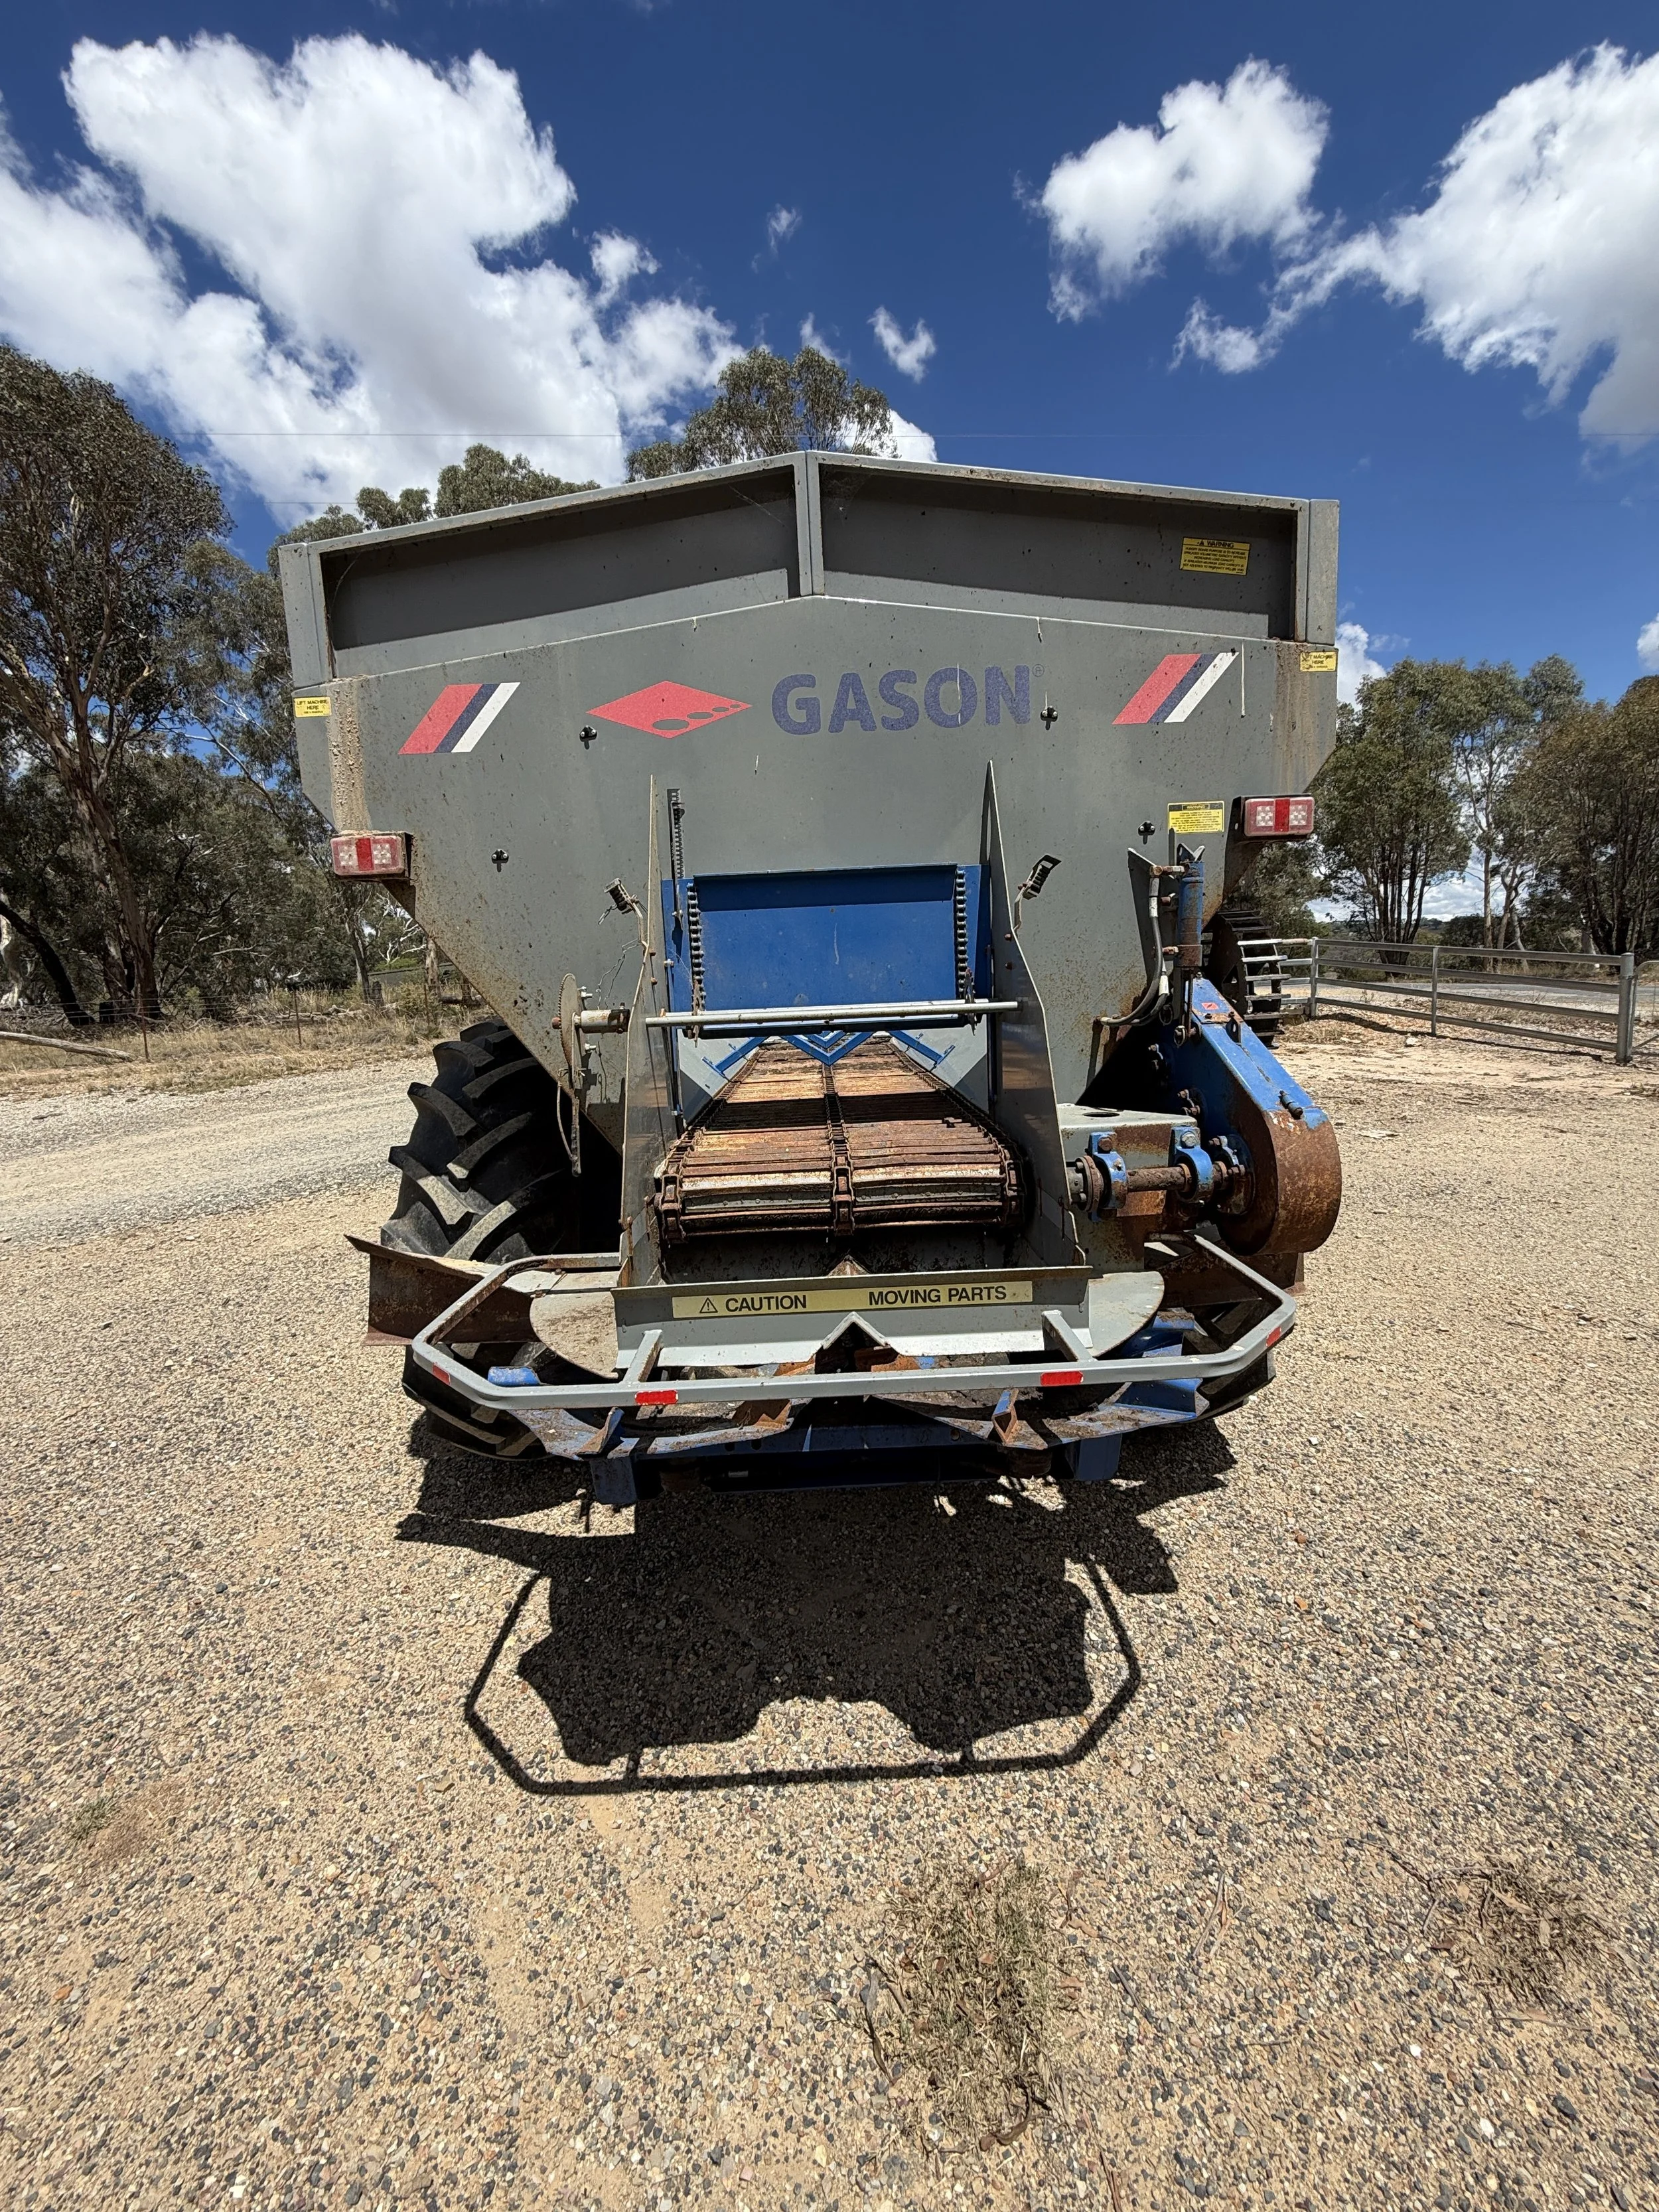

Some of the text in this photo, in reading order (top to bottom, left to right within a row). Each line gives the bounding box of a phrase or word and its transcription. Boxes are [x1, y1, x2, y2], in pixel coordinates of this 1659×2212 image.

[1207, 540, 1234, 549] WARNING
[771, 665, 1030, 735] GASON
[725, 1286, 1007, 1313] CAUTION MOVING PARTS
